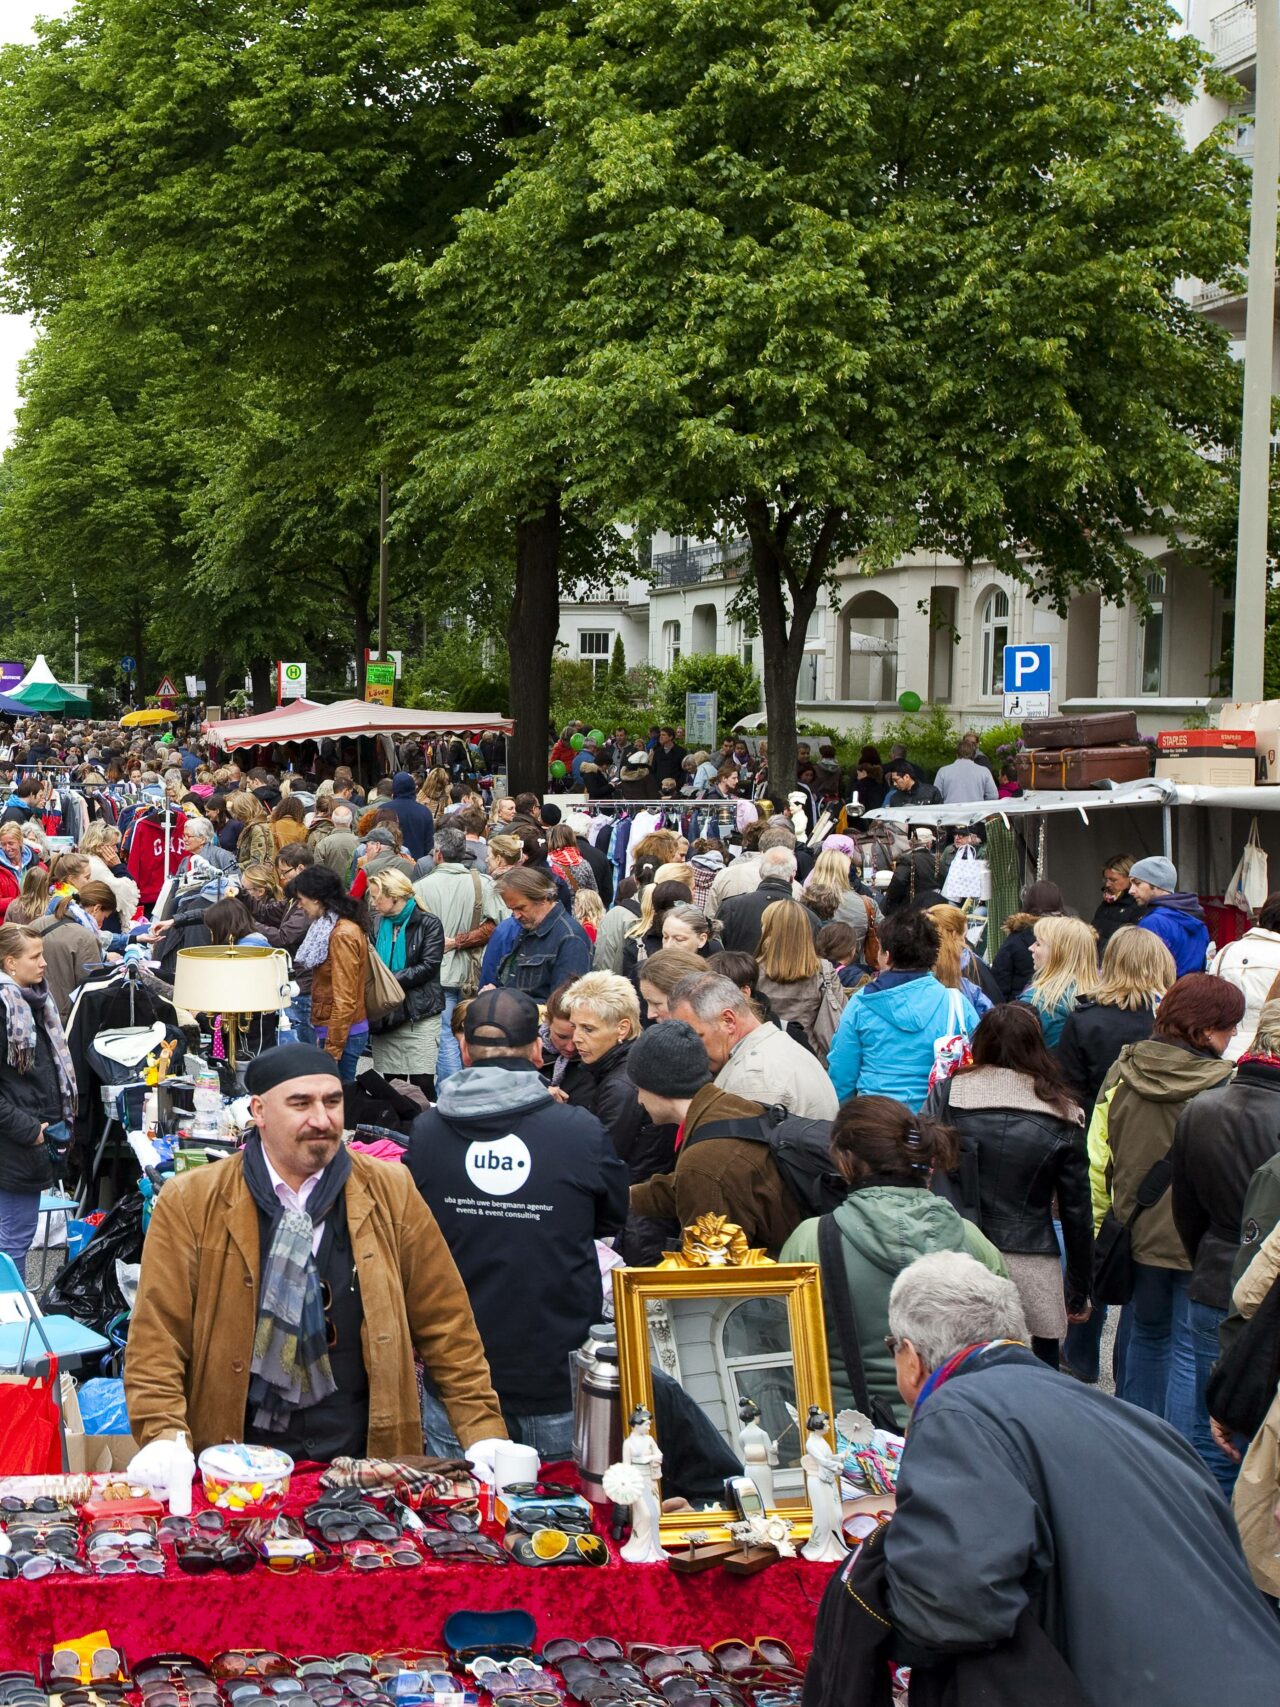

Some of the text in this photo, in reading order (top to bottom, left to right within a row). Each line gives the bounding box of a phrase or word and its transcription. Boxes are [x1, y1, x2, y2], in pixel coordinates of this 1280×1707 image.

[1014, 650, 1040, 687] P
[1162, 735, 1188, 746] STAPLES
[444, 1196, 456, 1204] uba
[457, 1198, 476, 1206] gmbh
[491, 1200, 526, 1210] bergmann
[527, 1203, 554, 1212] agentur
[456, 1207, 477, 1215] events
[485, 1209, 504, 1217] event
[504, 1211, 541, 1221] consulting
